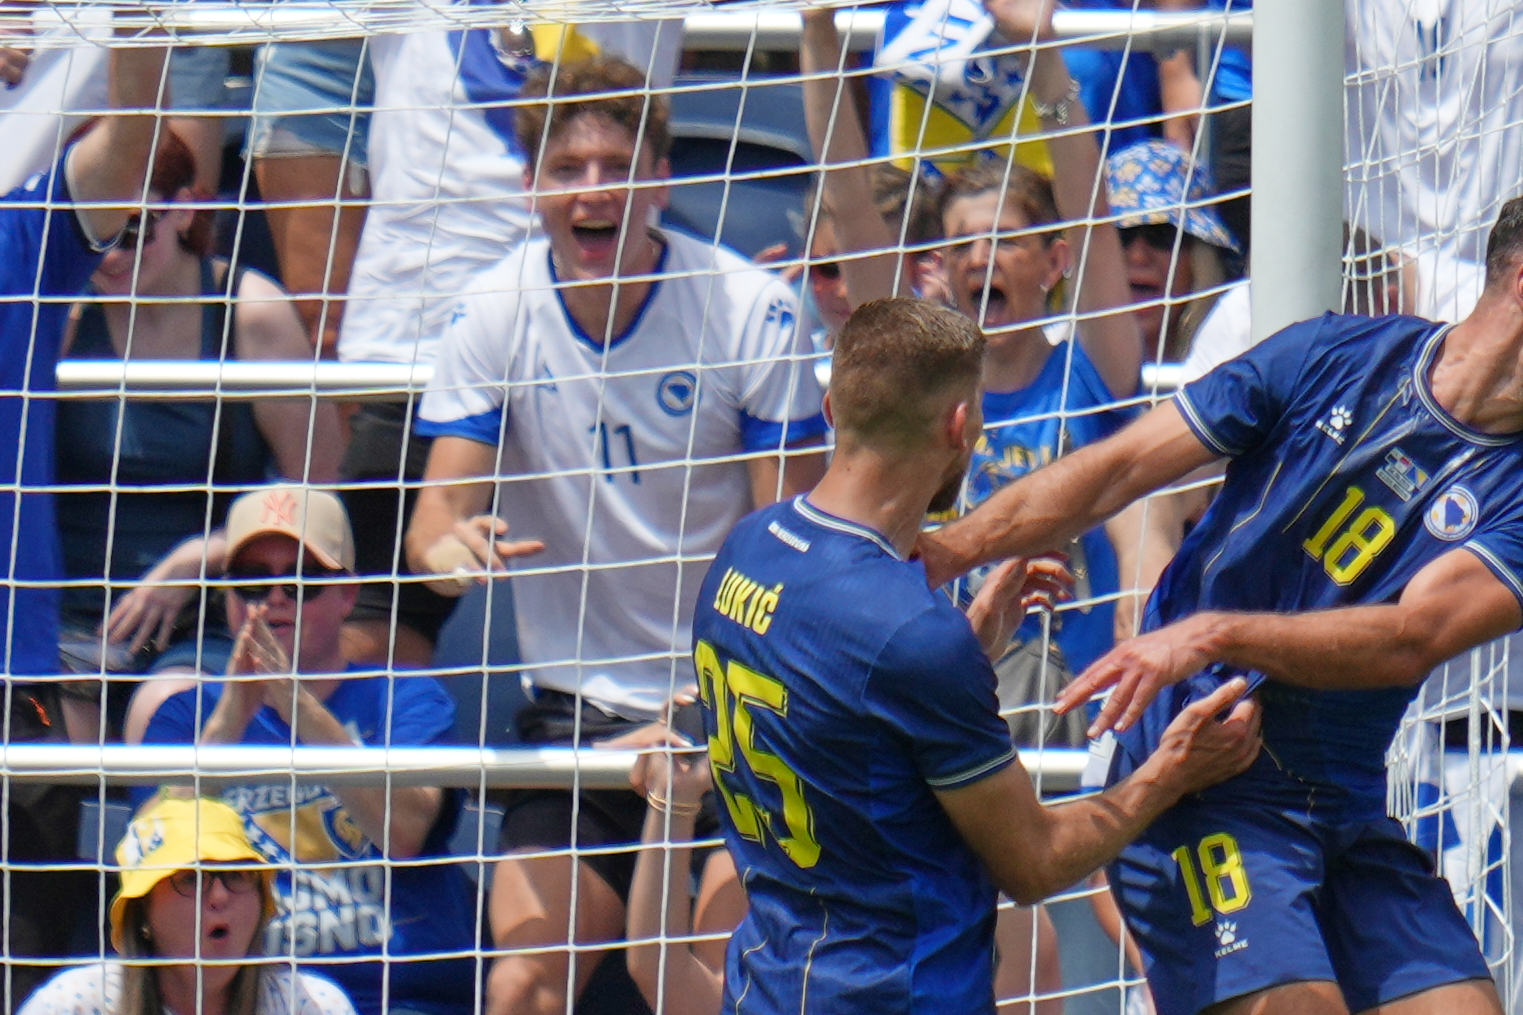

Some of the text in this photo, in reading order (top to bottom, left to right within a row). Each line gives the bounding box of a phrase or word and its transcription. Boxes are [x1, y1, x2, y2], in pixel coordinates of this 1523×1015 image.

[588, 421, 642, 485] 11
[1303, 484, 1396, 588] 18
[713, 565, 785, 636] LUKIĆ
[695, 638, 822, 869] 25
[1170, 831, 1252, 928] 18
[1214, 937, 1249, 959] KELME
